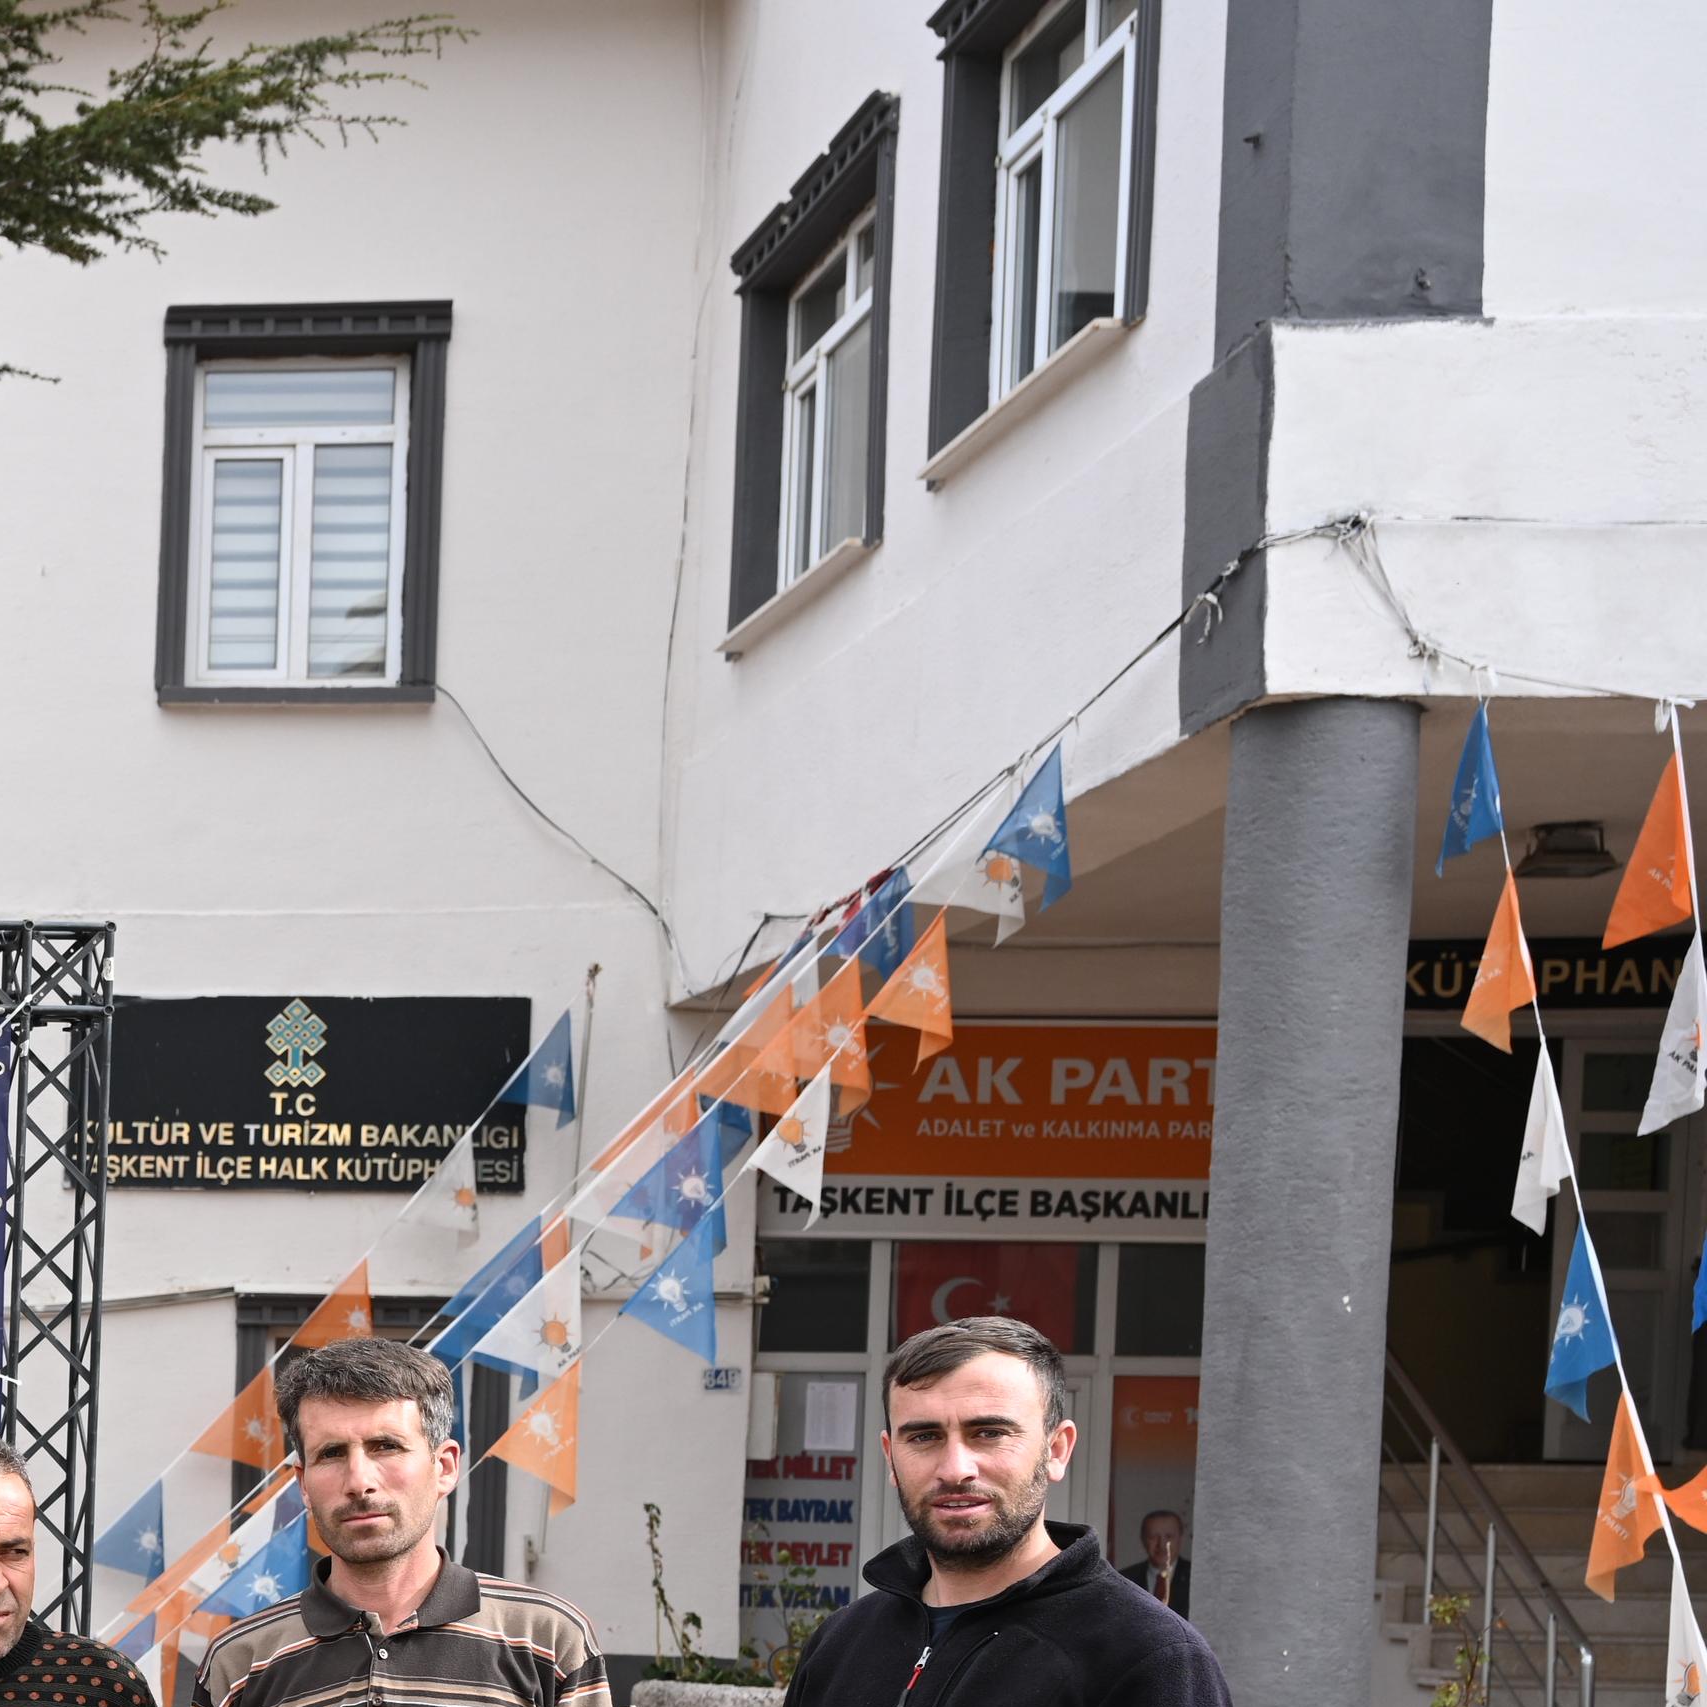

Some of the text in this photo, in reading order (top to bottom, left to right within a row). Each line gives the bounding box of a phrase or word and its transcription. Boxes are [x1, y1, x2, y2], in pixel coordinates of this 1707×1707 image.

[1406, 952, 1683, 998] KÜPHAN
[917, 1057, 1023, 1104] AK
[269, 1092, 316, 1116] T.C
[198, 1122, 234, 1146] VE
[243, 1119, 351, 1146] TURİZM
[917, 1119, 1004, 1138] ADALET
[1012, 1124, 1035, 1138] ve
[1043, 1120, 1158, 1139] KALKINMA
[196, 1151, 252, 1185] İLÇE
[259, 1156, 328, 1180] HALK
[338, 1152, 518, 1183] KÜTÜPHESİ
[773, 1186, 933, 1220] TAŞKENT
[944, 1183, 1022, 1221] İLÇE
[783, 1451, 856, 1480] MİLLET
[777, 1499, 853, 1523] BAYRAK
[777, 1541, 853, 1566] DEVLET
